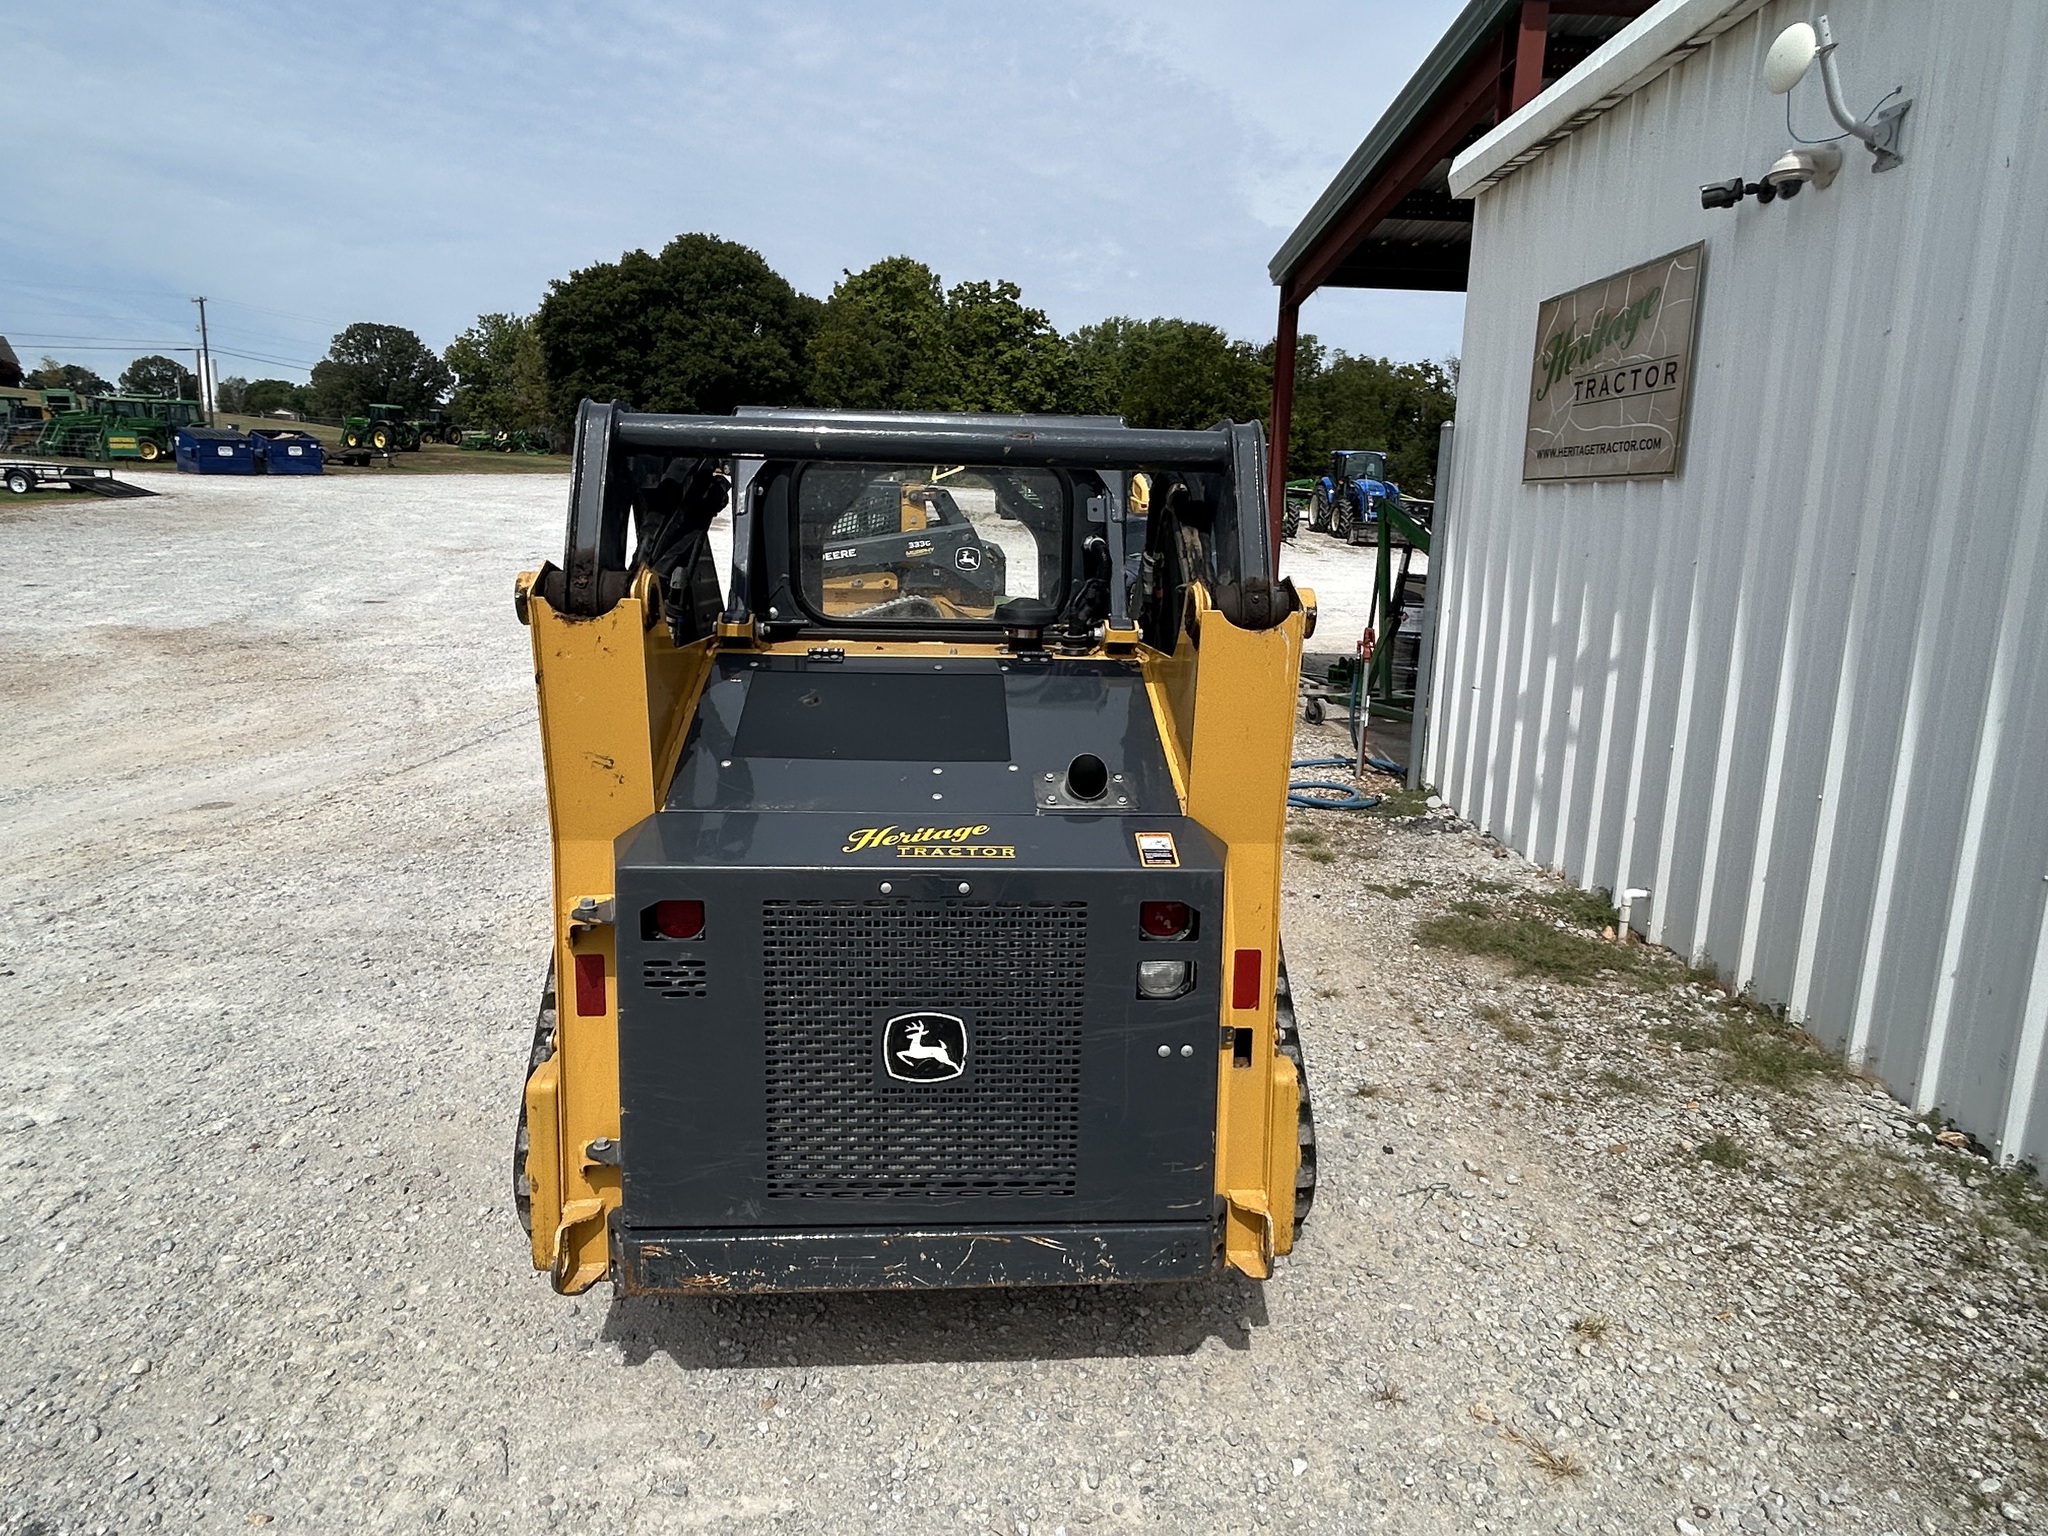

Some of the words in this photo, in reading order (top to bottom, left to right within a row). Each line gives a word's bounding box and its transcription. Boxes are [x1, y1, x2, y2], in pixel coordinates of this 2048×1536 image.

[1537, 286, 1662, 401] Heritage
[1574, 361, 1678, 401] TRACTOR
[1536, 438, 1662, 459] WWW.HERITAGETRACTOR.COM
[823, 549, 857, 560] EERE
[842, 824, 990, 853] Heritage
[899, 846, 1016, 857] TRACTOR
